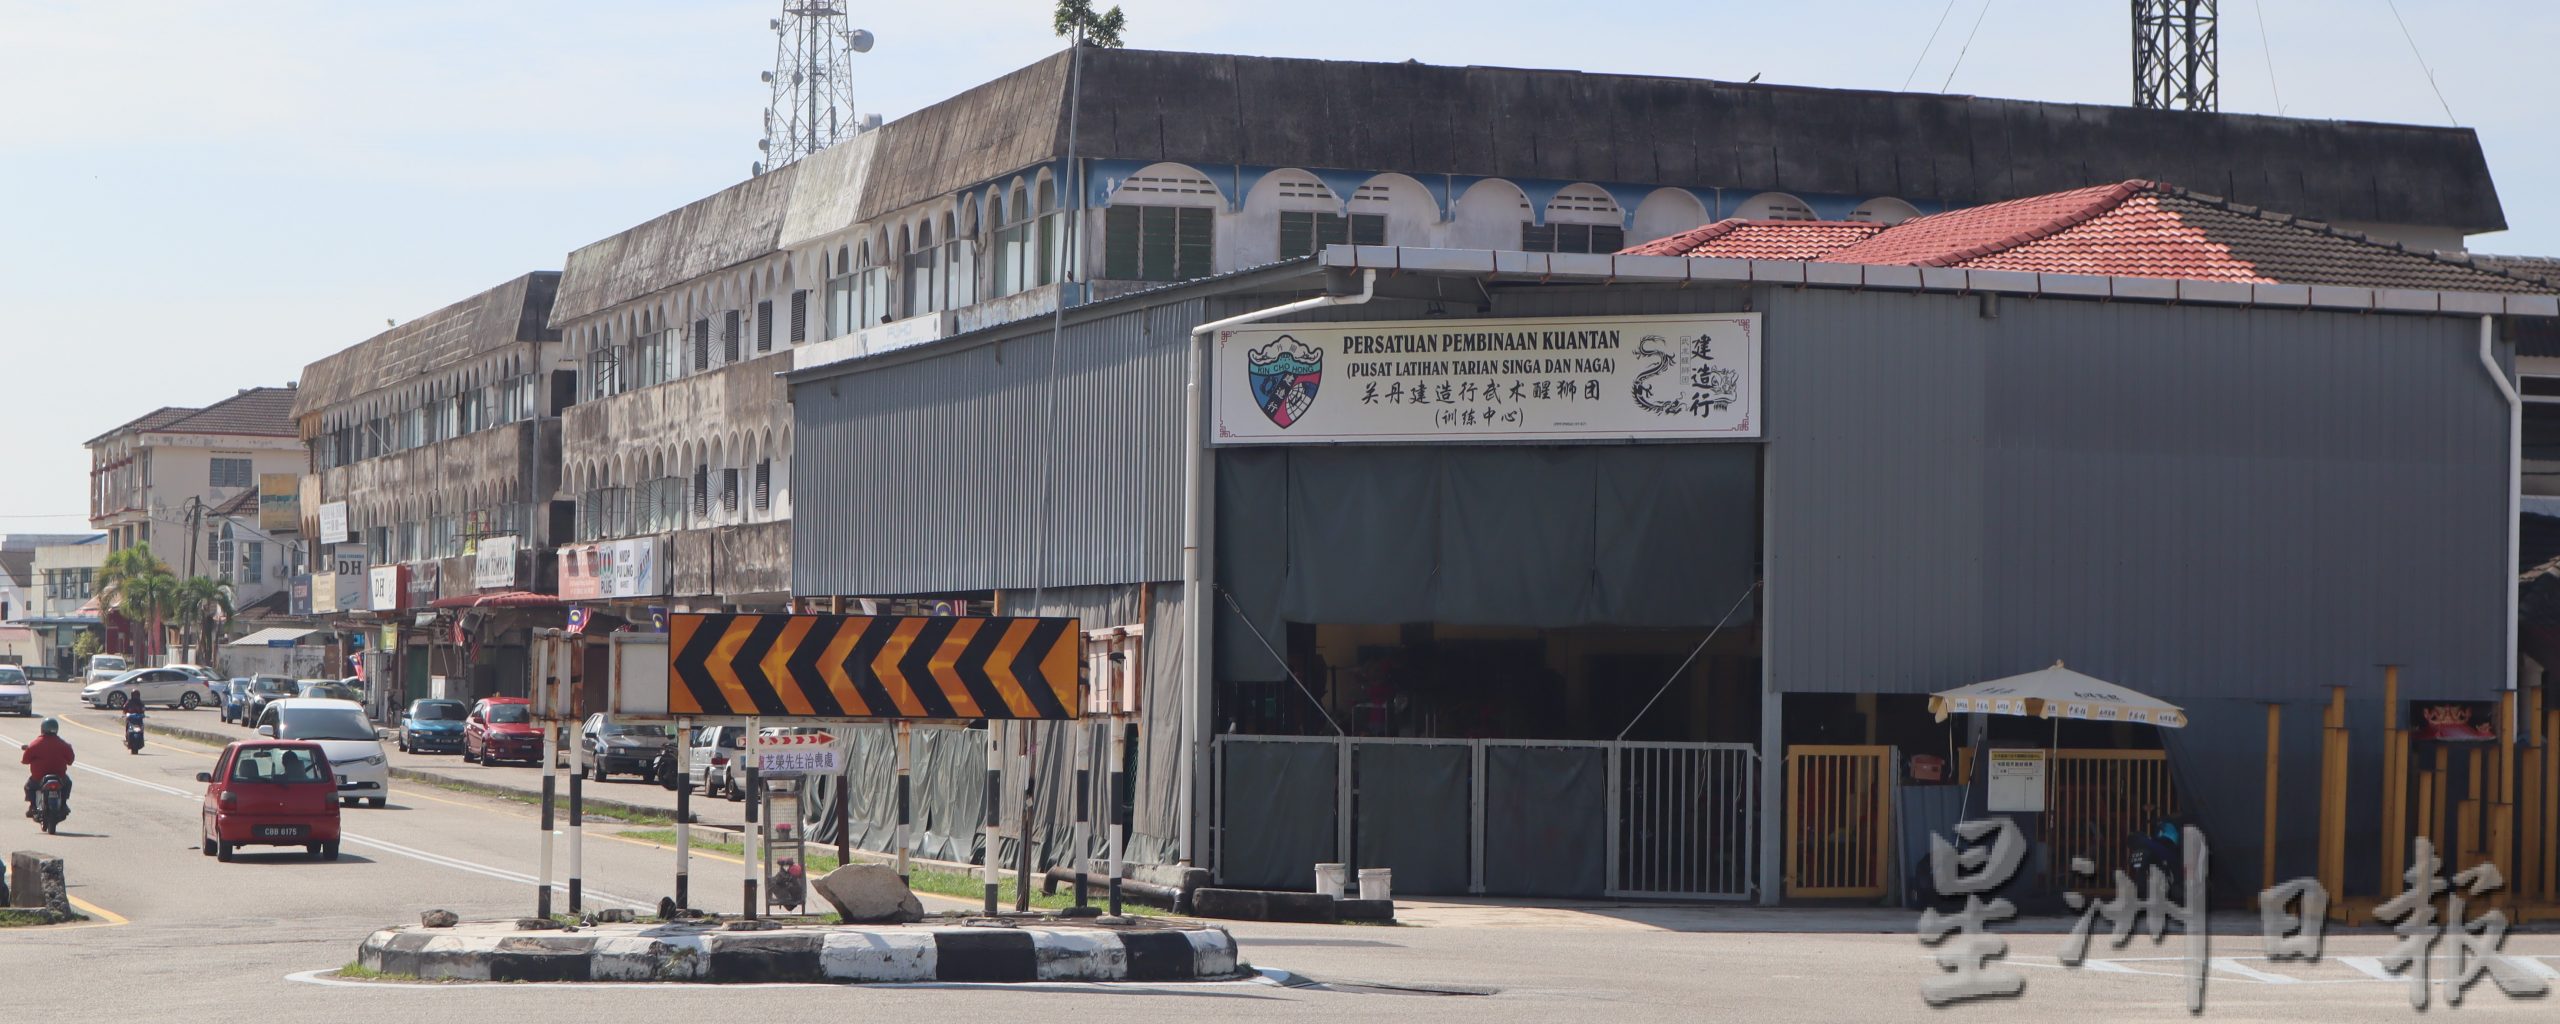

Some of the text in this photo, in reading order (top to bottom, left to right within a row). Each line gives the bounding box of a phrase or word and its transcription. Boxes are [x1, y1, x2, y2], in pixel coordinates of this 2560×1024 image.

[1343, 330, 1620, 354] PERSATUAN PEMBINAAN KUANTAN
[1273, 363, 1290, 372] CHO
[1292, 365, 1314, 374] HONG
[1347, 357, 1615, 379] (PUSAT LATIHAN TARIAN SINGA DAN NAGA)
[1690, 334, 1714, 418] 建造行
[1361, 379, 1600, 404] 关丹建造行武术醒狮团
[1435, 407, 1524, 427] (训练中心)
[339, 561, 362, 575] DH
[375, 579, 385, 597] DH
[601, 580, 612, 594] PLUS
